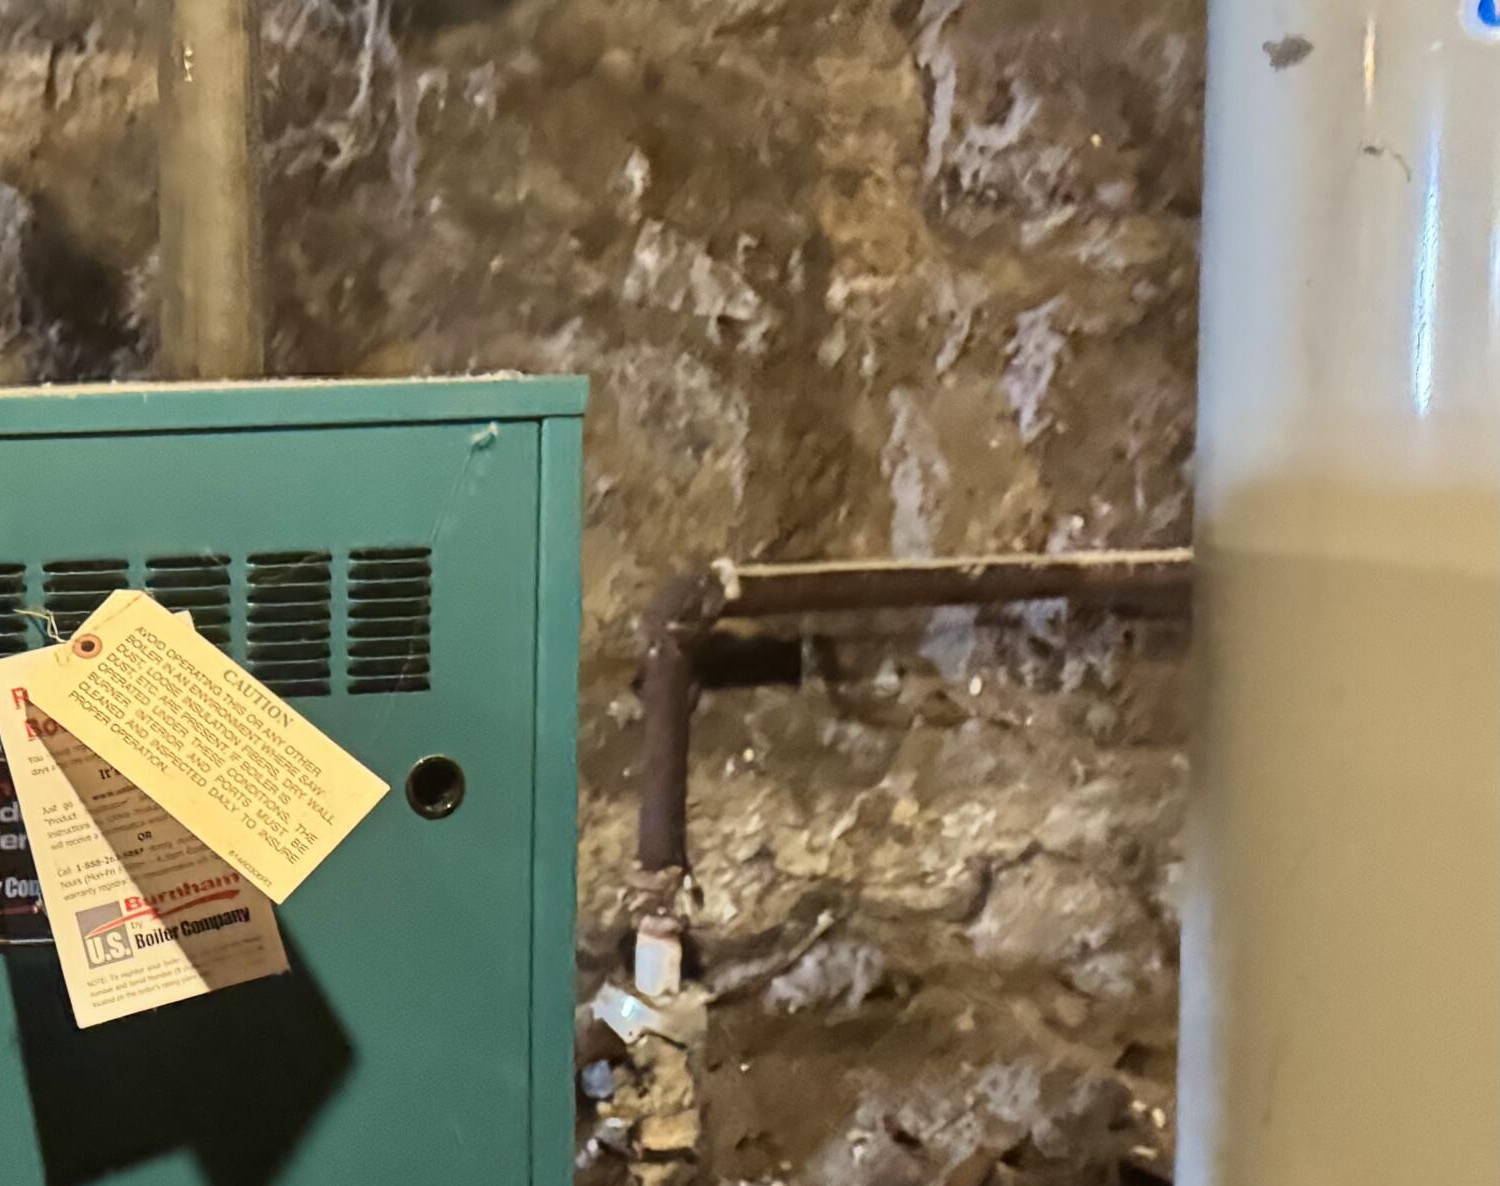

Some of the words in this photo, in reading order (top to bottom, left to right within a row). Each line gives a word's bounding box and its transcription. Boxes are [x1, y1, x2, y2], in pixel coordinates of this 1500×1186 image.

[67, 689, 112, 726] PROPER
[77, 680, 126, 720] CLEANED
[124, 719, 149, 739] AND
[149, 739, 208, 788] INSPECTED
[207, 786, 240, 813] DAILY
[240, 812, 257, 830] TO
[257, 829, 301, 865] INSURE
[86, 670, 132, 708] BURNER
[135, 709, 185, 752] INTERIOR
[186, 752, 212, 774] AND
[213, 774, 253, 808] PORTS
[255, 808, 289, 837] MUST
[290, 837, 309, 855] BE
[97, 661, 151, 706] OPERATED
[151, 705, 190, 738] UNDER
[191, 736, 226, 769] THESE
[294, 822, 319, 846] THE
[124, 633, 164, 665] BOILER
[162, 662, 176, 675] IN
[172, 672, 191, 687] AN
[188, 683, 263, 745] ENVIRONMENT
[260, 742, 301, 777] WHERE
[298, 774, 326, 796] SAW
[134, 626, 167, 651] AVOID
[165, 648, 223, 697] OPERATING
[222, 692, 248, 716] THIS
[245, 713, 265, 730] OR
[261, 727, 287, 747] ANY
[284, 744, 322, 778] OTHER
[145, 666, 184, 698] LOOSE
[181, 695, 242, 747] INSULATION
[281, 777, 308, 800] DRY
[306, 797, 335, 826] WALL
[158, 695, 183, 715] ARE
[228, 751, 243, 762] IF
[239, 760, 280, 795] BOILER
[277, 792, 292, 806] IS
[223, 669, 295, 729] CAUTION
[85, 932, 132, 965] U.S.
[135, 925, 181, 950] Boiler
[181, 907, 250, 938] Company
[123, 872, 240, 912] Burnham
